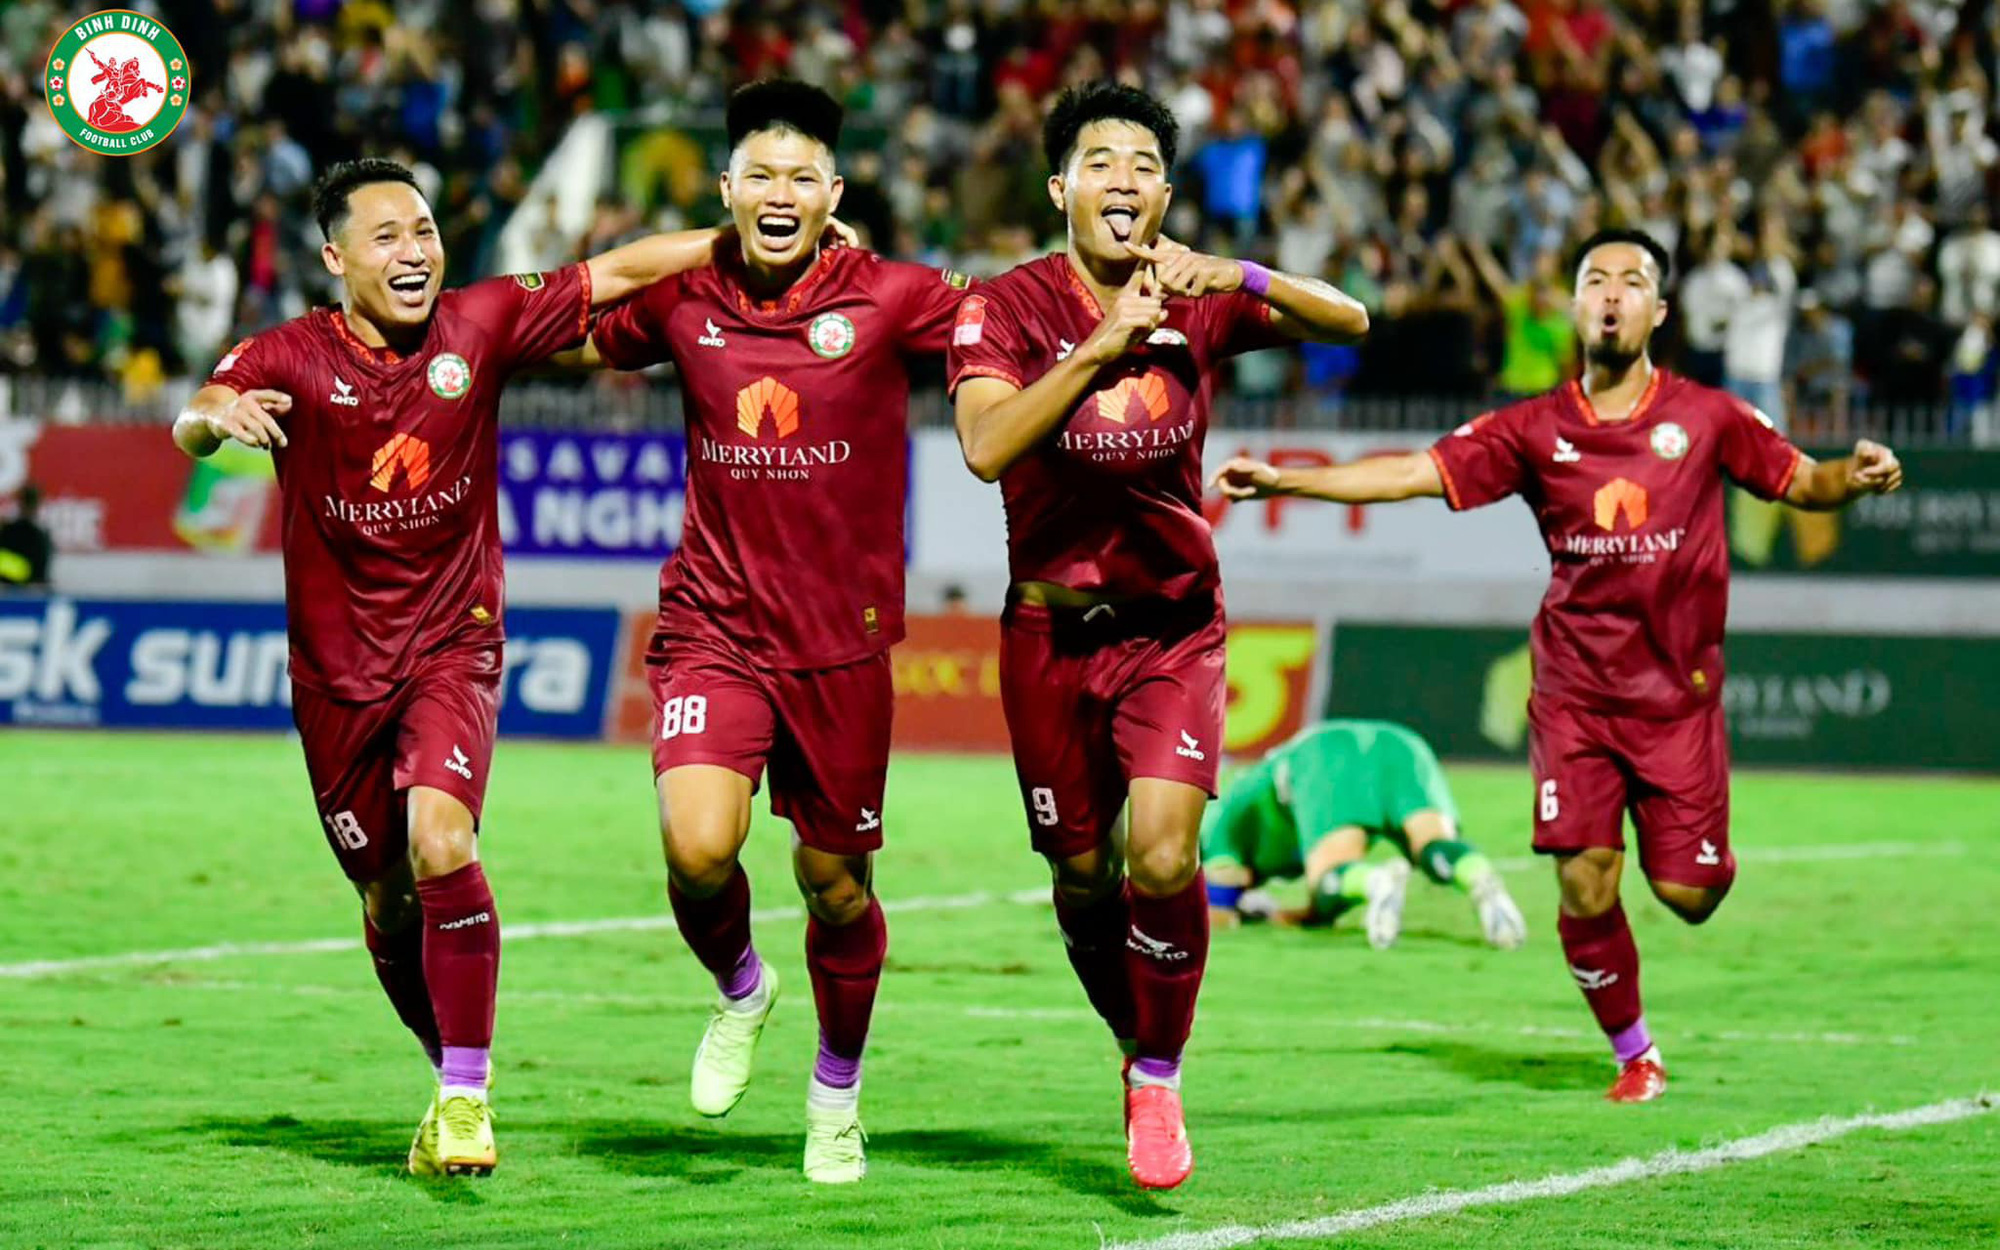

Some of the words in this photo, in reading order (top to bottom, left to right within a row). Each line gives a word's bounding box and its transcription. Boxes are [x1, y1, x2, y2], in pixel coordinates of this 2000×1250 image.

[507, 437, 688, 484] SAVA
[701, 438, 851, 466] MERRYLAND
[730, 468, 760, 480] QUY
[362, 523, 392, 537] QUY
[661, 694, 708, 741] 88
[1031, 786, 1059, 826] 9
[1540, 778, 1559, 822] 6
[324, 810, 369, 850] 18
